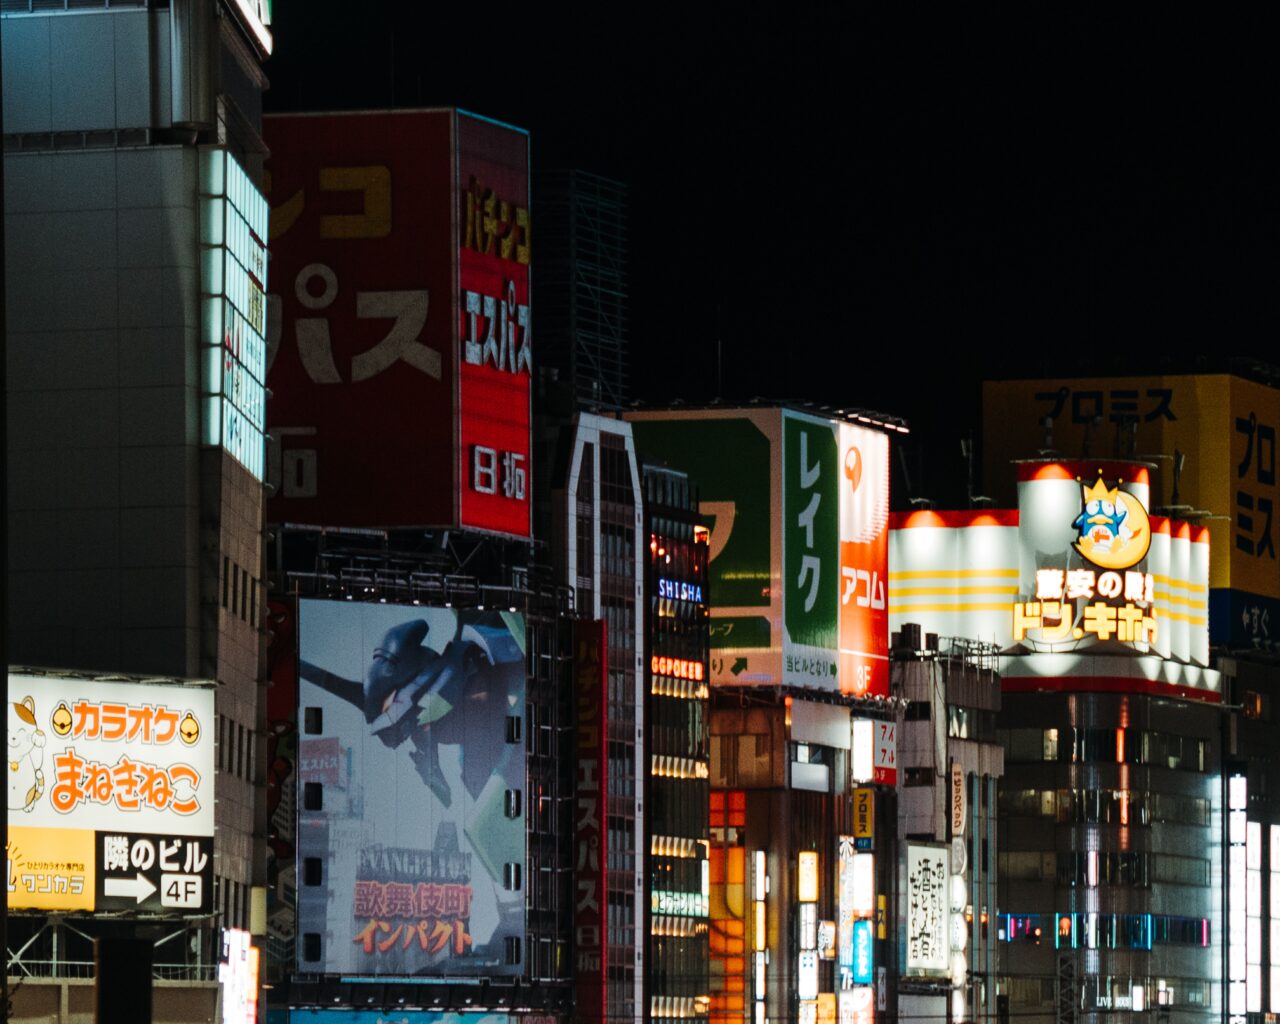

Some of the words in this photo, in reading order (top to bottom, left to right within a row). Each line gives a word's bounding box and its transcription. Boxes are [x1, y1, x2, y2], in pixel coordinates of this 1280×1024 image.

[464, 175, 530, 265] パチンコ
[465, 280, 532, 374] エスパス
[1036, 386, 1177, 424] プロミス
[473, 445, 527, 500] 日拓
[798, 430, 823, 613] レイク
[659, 578, 702, 603] SHISHA
[841, 567, 886, 611] アコム
[651, 655, 704, 681] GGPOKER
[72, 701, 182, 745] カラオケ
[51, 749, 202, 815] まねきねこ
[859, 792, 868, 834] プロミス
[104, 834, 208, 874] 隣のビル
[577, 758, 600, 916] エスパス
[21, 873, 86, 895] ワンカラ
[27, 862, 86, 872] ひとりカラオケ専門店
[166, 880, 198, 902] 4F
[355, 880, 474, 918] 歌舞伎町
[353, 919, 473, 954] インパクト
